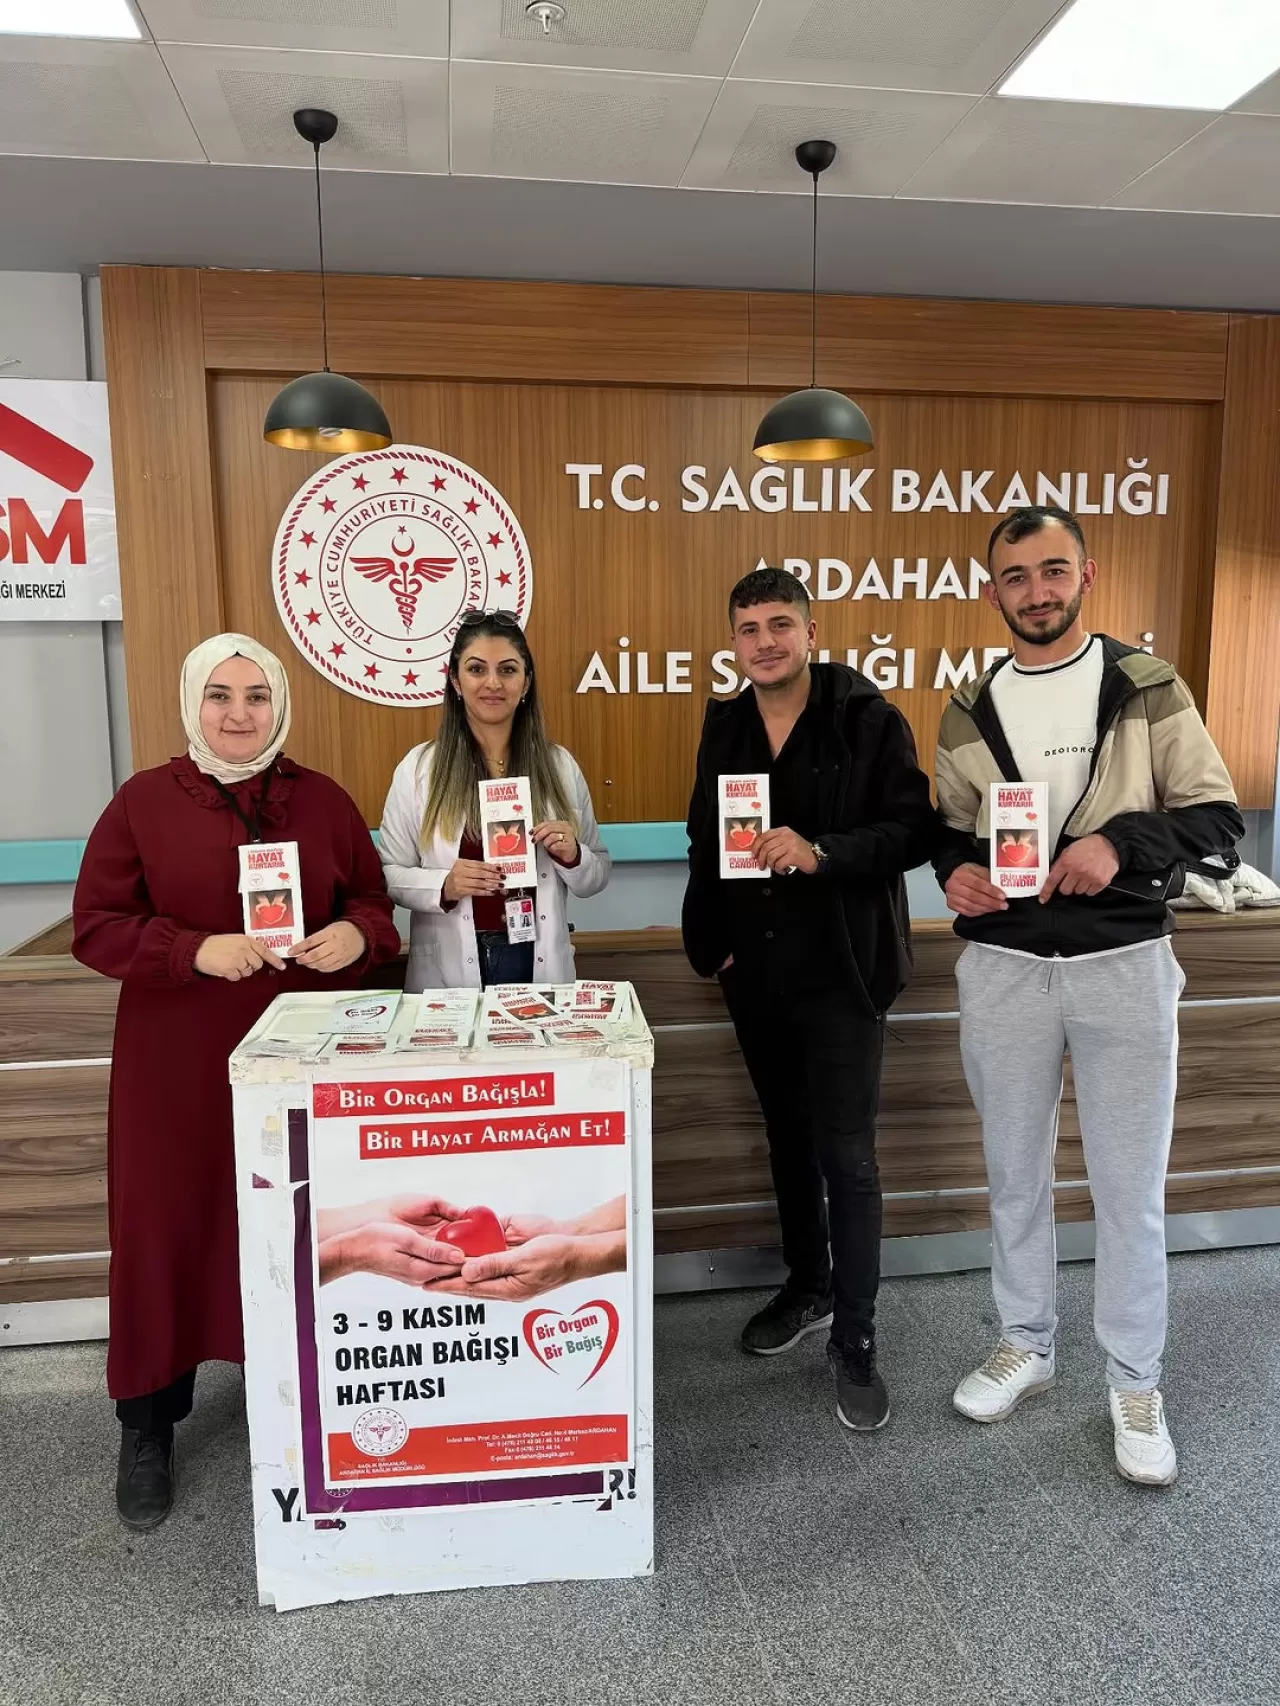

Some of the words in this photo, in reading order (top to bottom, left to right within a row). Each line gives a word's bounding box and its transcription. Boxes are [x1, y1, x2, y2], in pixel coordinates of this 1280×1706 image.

[565, 463, 660, 512] T.C.
[680, 458, 875, 513] SAĞLIK
[891, 457, 1170, 515] BAKANLIĞI
[326, 498, 416, 573] CUMHURİYETİ
[421, 504, 474, 553] SAĞLIK
[16, 580, 66, 598] MERKEZİ
[754, 556, 992, 600] RDAHAN
[328, 579, 373, 646] TÜRKİYE
[576, 636, 692, 693] AİLE
[486, 785, 519, 797] HAYAT
[725, 782, 758, 792] HAYAT
[998, 791, 1033, 802] HAYAT
[247, 852, 284, 864] HAYAT
[1000, 880, 1037, 888] CANDIR
[333, 1313, 349, 1335] 3
[377, 1310, 393, 1332] 9
[403, 1303, 486, 1330] KASIM
[536, 1324, 556, 1340] Bir
[558, 1313, 599, 1335] Organ
[335, 1343, 423, 1372] ORGAN
[433, 1332, 519, 1366] BAĞIŞI
[543, 1346, 563, 1361] Bir
[565, 1336, 603, 1354] Bağış
[336, 1377, 445, 1406] HAFTASI
